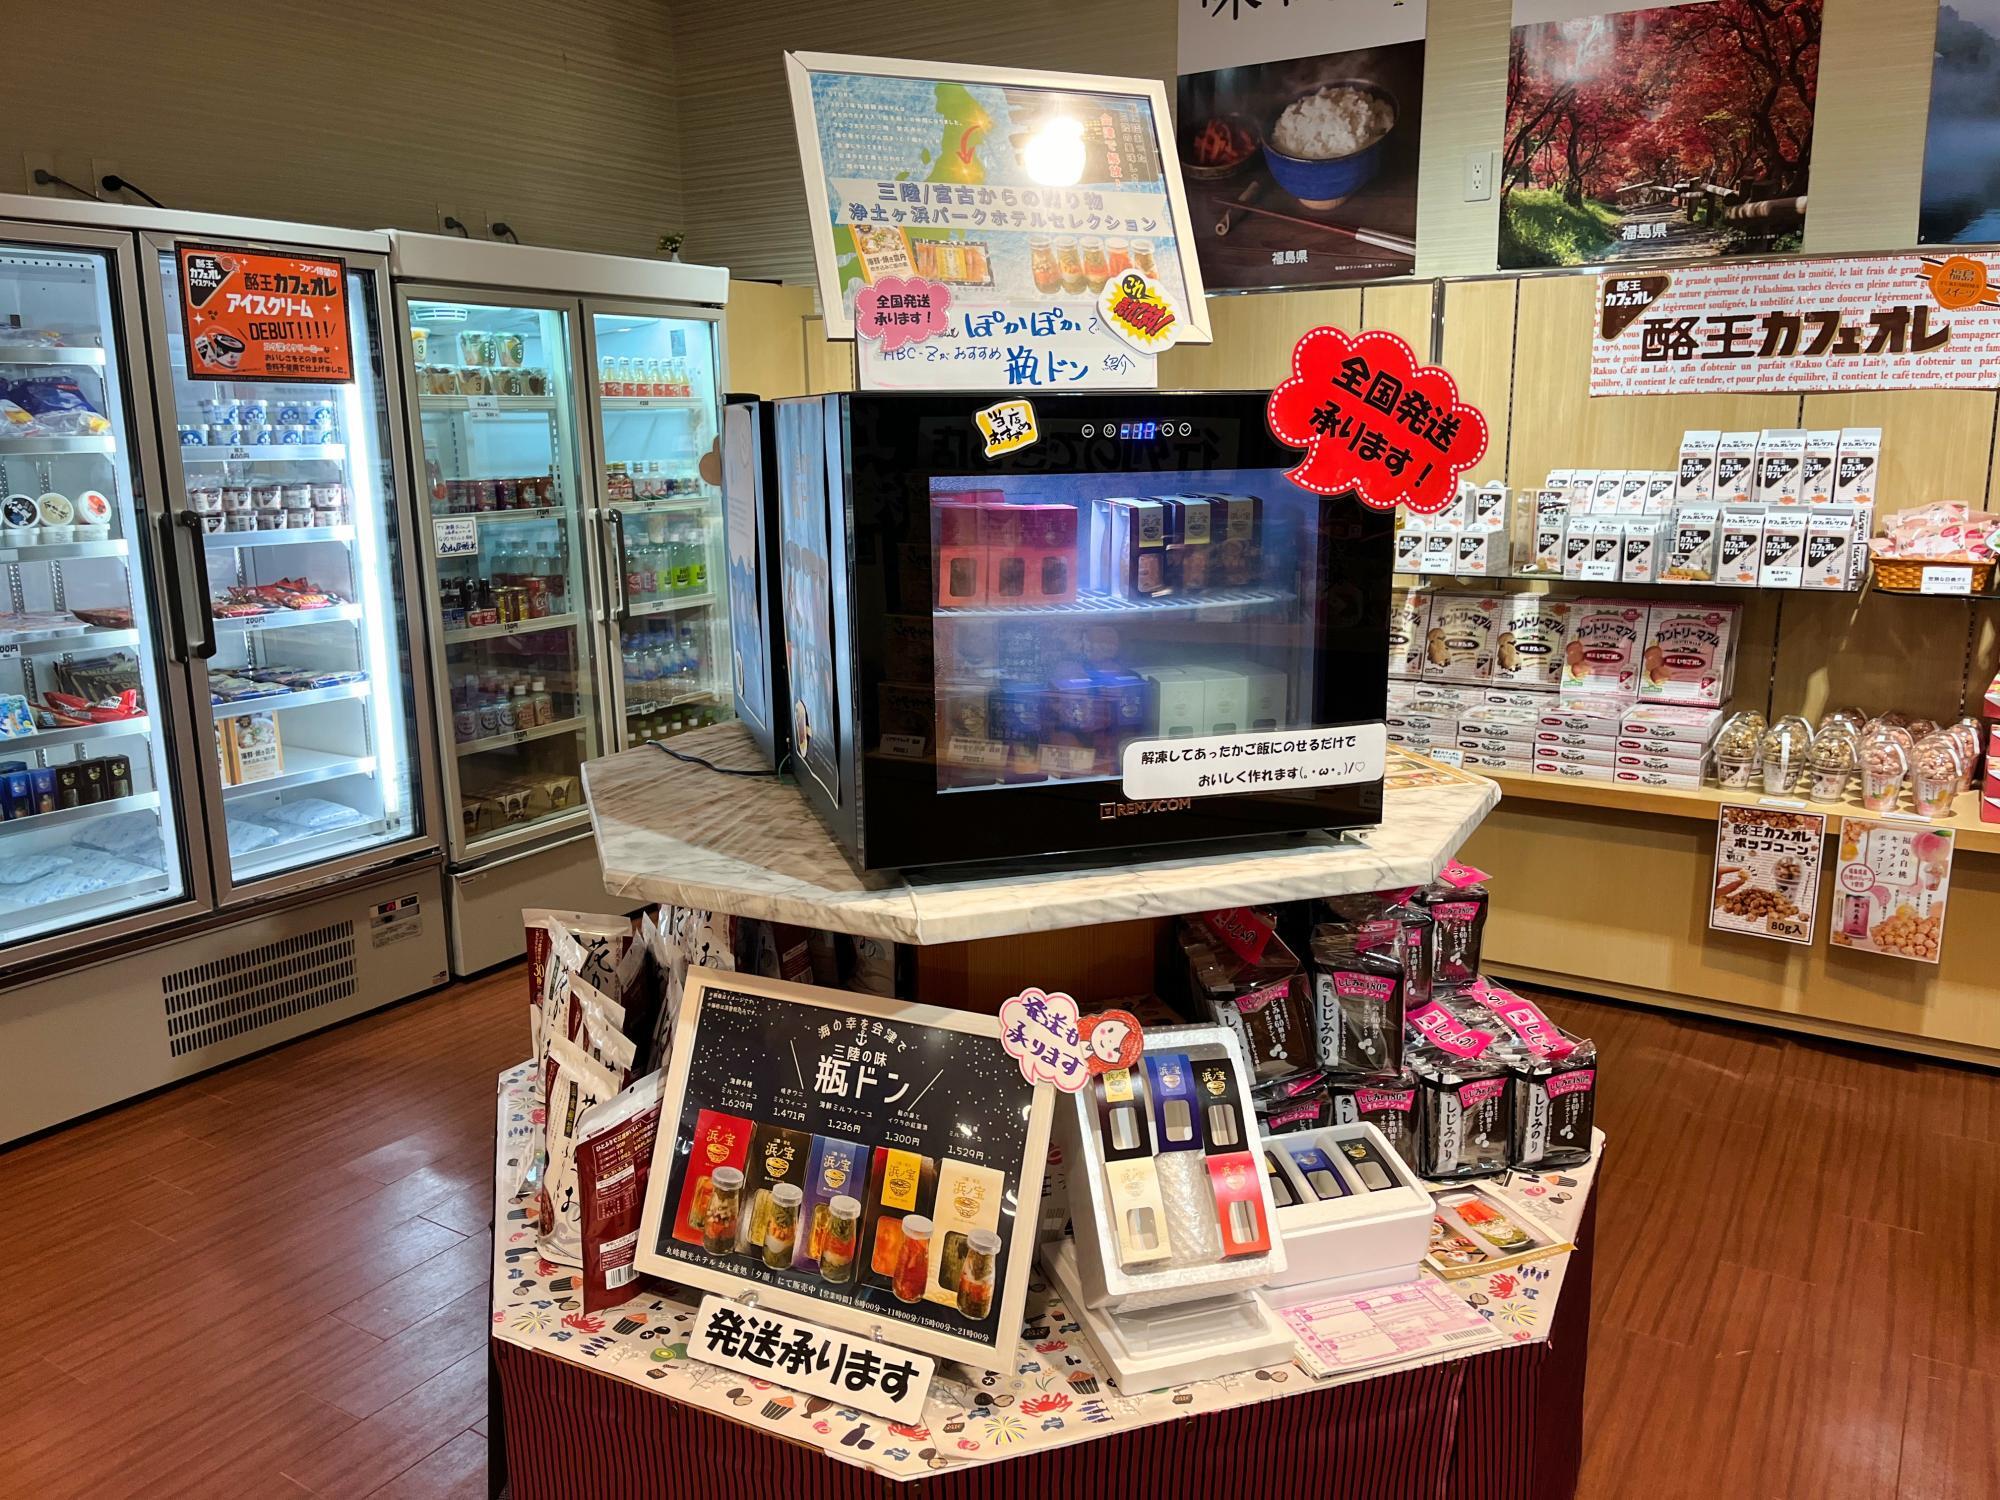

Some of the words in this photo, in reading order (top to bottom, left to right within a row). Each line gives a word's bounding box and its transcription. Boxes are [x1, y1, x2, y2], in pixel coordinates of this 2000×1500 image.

[1621, 223, 1668, 240] 福島県
[1271, 249, 1308, 265] 福島県
[189, 268, 221, 281] カフェオレ
[243, 272, 338, 297] 酪王カフェオレ
[1674, 278, 1683, 286] de
[1685, 277, 1712, 287] grande
[1714, 273, 1740, 286] qualité
[1741, 273, 1780, 286] provenant
[1782, 271, 1796, 280] des
[1799, 270, 1806, 278] la
[1840, 268, 1847, 276] le
[1850, 267, 1863, 276] lait
[1867, 266, 1885, 275] frais
[1888, 266, 1898, 274] de
[1123, 275, 1143, 297] これ
[1616, 280, 1642, 292] 酪王
[1704, 287, 1739, 299] généreuse
[1742, 287, 1750, 295] de
[1825, 280, 1851, 290] élevées
[1867, 279, 1890, 291] pleine
[1893, 279, 1917, 287] nature
[226, 293, 314, 318] アイスクリーム
[876, 294, 931, 309] 全国発送
[1604, 291, 1653, 307] カフェオレ
[1751, 298, 1759, 306] la
[1838, 293, 1872, 302] douceur
[1875, 292, 1922, 304] légèrement
[874, 309, 932, 325] 承ります！
[964, 307, 1081, 338] ぽかぽか
[1641, 305, 1951, 361] 酪王カフェオレ
[1101, 353, 1136, 376] 紹介
[1680, 363, 1696, 372] afin
[1758, 362, 1785, 372] parfait
[1893, 358, 1910, 366] afin
[1634, 377, 1666, 386] contient
[1669, 376, 1676, 384] le
[1679, 375, 1695, 385] café
[1697, 375, 1725, 385] tendre,
[1736, 376, 1755, 386] pour
[1756, 375, 1773, 384] plus
[1841, 372, 1876, 380] contient
[1892, 370, 1908, 379] café
[1911, 370, 1943, 380] tendre,
[1955, 372, 1975, 381] pour
[1978, 370, 1996, 380] plus
[1331, 356, 1462, 453] 全国発送
[1308, 400, 1434, 488] 承ります！
[1438, 612, 1492, 631] カントリーマアム
[1508, 616, 1566, 634] カントリーマアム
[1576, 623, 1637, 643] カントリーマアム
[1655, 627, 1721, 648] カントリーマアム
[1141, 735, 1357, 765] 解凍してあったかご飯にのせるだけで
[1733, 823, 1812, 843] 酪王カフェオレ
[1734, 837, 1809, 856] ポップコーン
[1771, 921, 1803, 935] 80g入
[1021, 996, 1080, 1047] 発送も
[1320, 994, 1336, 1061] しじみのり
[817, 1016, 907, 1053] 海の幸を会津で
[832, 1043, 888, 1067] 三陸の味
[1006, 1020, 1085, 1076] 承ります
[813, 1054, 910, 1104] 瓶ドン
[1201, 1070, 1227, 1082] 浜ノ宝
[721, 1086, 758, 1100] ミルフィーユ
[773, 1095, 808, 1109] ミルフィーユ
[1443, 1100, 1456, 1161] しじみのり
[1530, 1092, 1544, 1155] しじみのり
[707, 1129, 736, 1147] 浜ノ宝
[765, 1141, 796, 1161] 浜ノ宝
[823, 1154, 852, 1173] 浜ノ宝
[665, 1245, 716, 1267] 丸峰観光ホテル
[704, 1307, 920, 1404] 発送承ります
